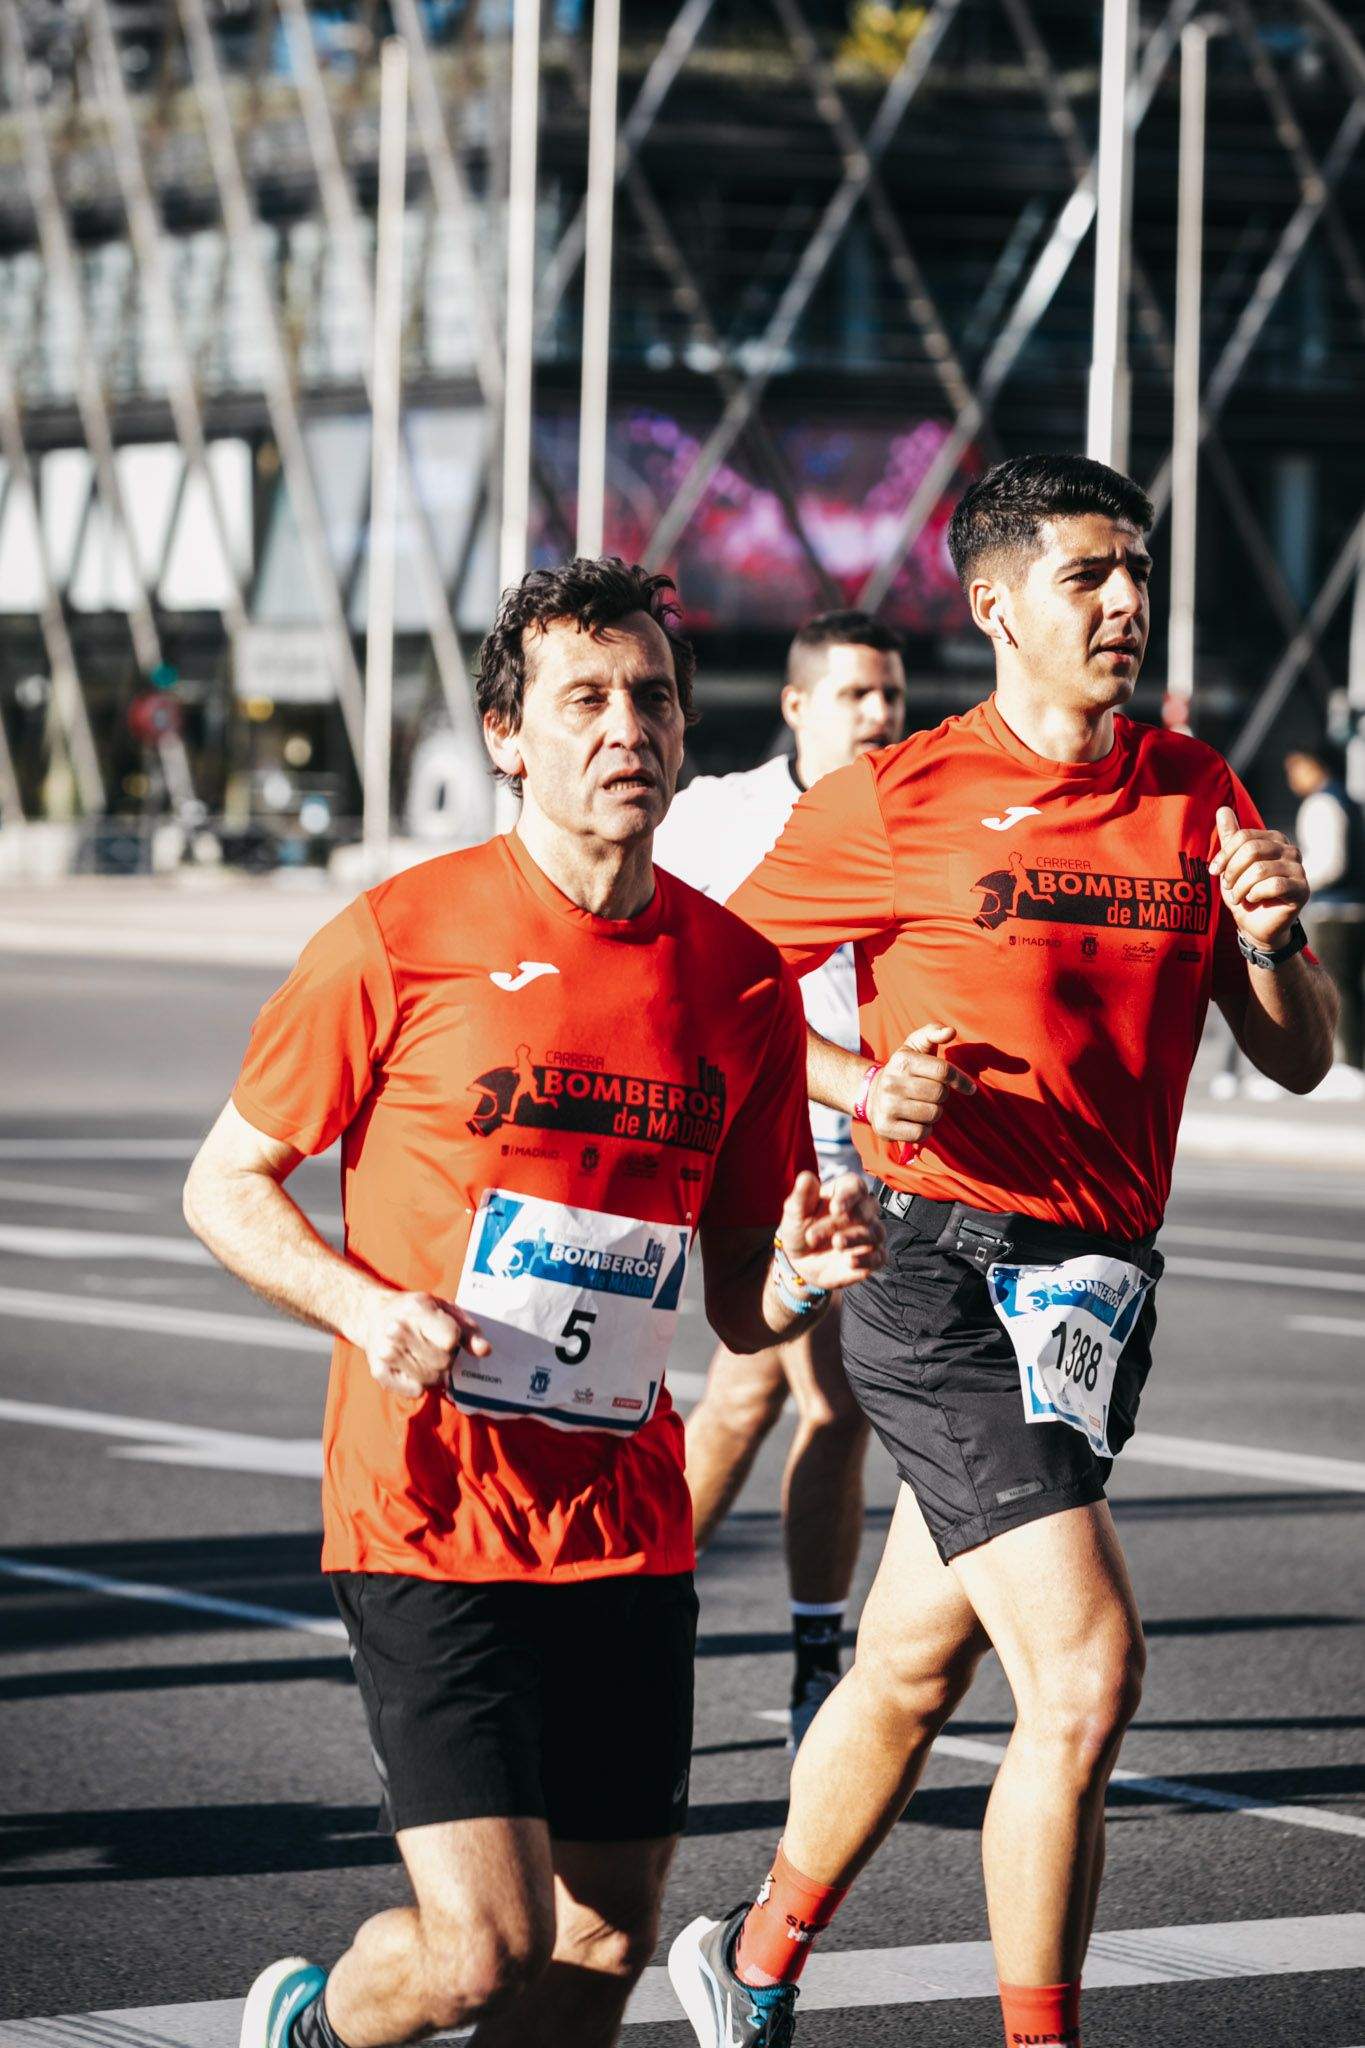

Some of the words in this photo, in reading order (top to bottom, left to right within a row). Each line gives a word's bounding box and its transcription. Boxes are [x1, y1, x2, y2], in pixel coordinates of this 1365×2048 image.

[1035, 856, 1091, 870] CARRERA
[1037, 871, 1208, 905] BOMBEROS
[1106, 899, 1131, 925] de
[1138, 903, 1207, 932] MADRID
[545, 1050, 605, 1069] CARRERA
[543, 1070, 721, 1121] BOMBEROS
[613, 1106, 640, 1135] de
[646, 1110, 720, 1150] MADRID
[549, 1243, 660, 1278] BOMBEROS
[1059, 1279, 1122, 1308] BOMBEROS
[555, 1310, 597, 1366] 5
[1051, 1321, 1104, 1393] 1388
